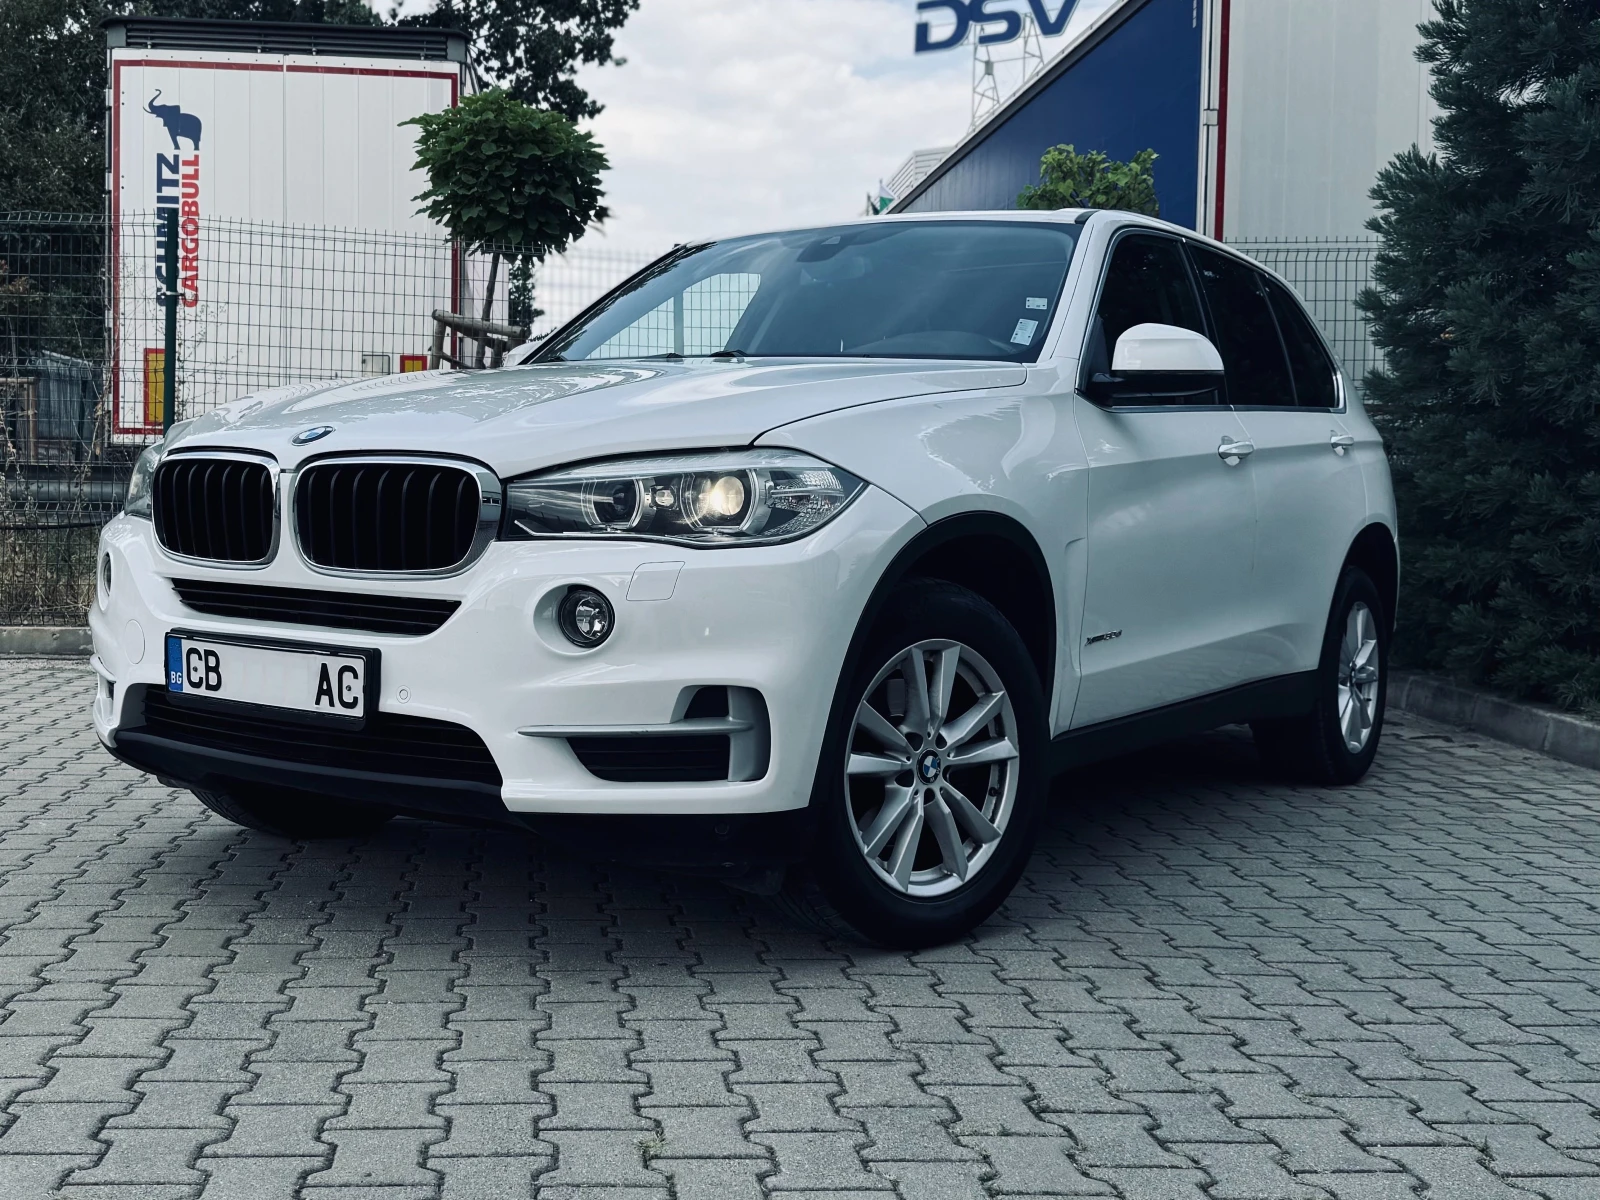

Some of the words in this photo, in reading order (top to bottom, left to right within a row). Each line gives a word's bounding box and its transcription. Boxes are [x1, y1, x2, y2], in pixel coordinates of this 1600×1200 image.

[915, 0, 1080, 52] DSV
[182, 154, 199, 308] CARGOBULL
[171, 671, 182, 684] BG
[185, 647, 222, 692] CB
[314, 662, 359, 710] AC
